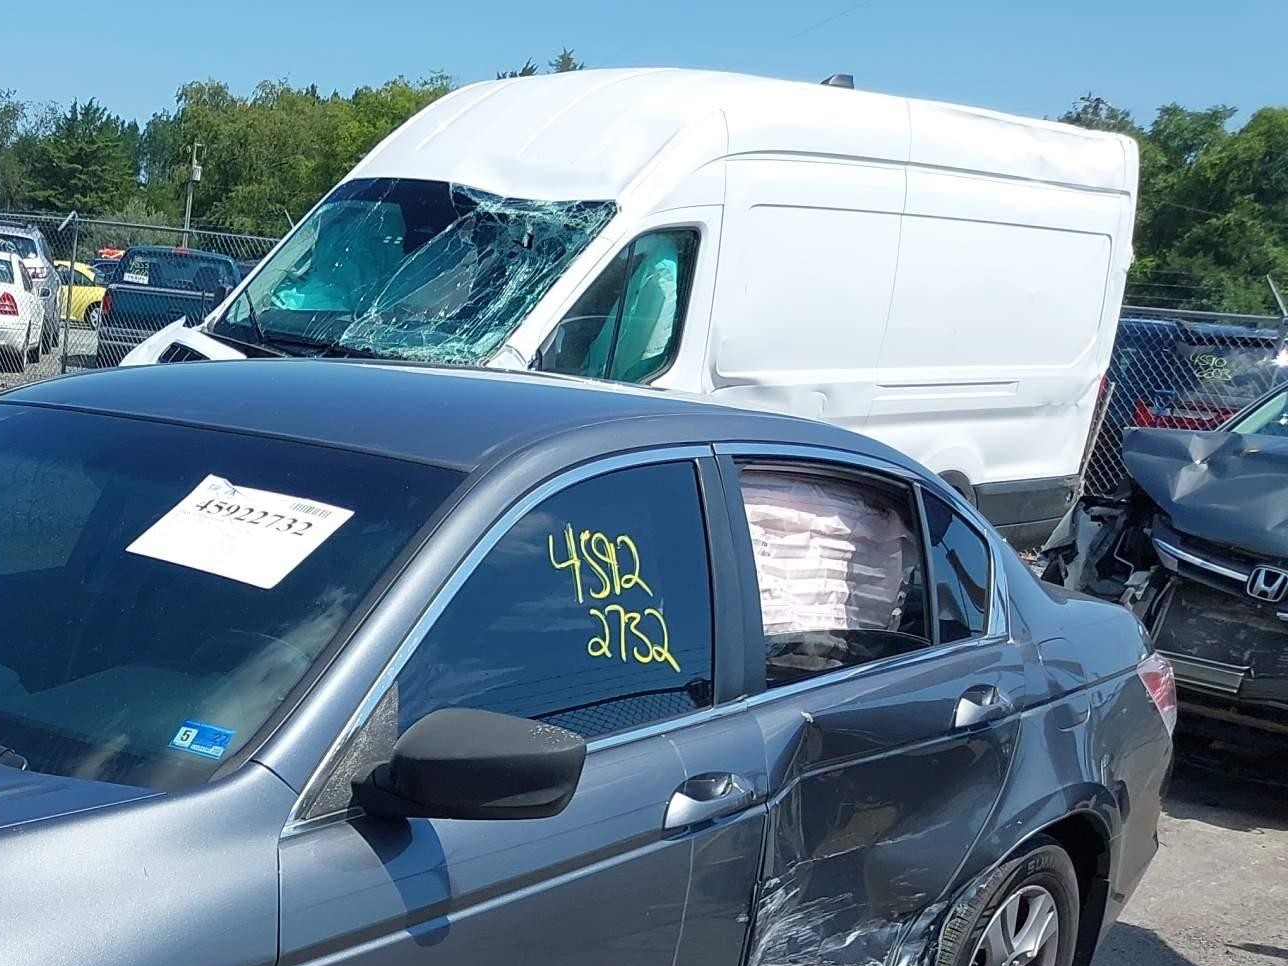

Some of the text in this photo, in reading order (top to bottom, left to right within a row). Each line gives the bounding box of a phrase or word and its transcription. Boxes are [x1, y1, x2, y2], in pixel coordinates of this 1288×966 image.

[195, 499, 314, 536] 45922732
[548, 522, 654, 604] 4592
[587, 604, 681, 673] 2732
[180, 729, 192, 742] 5
